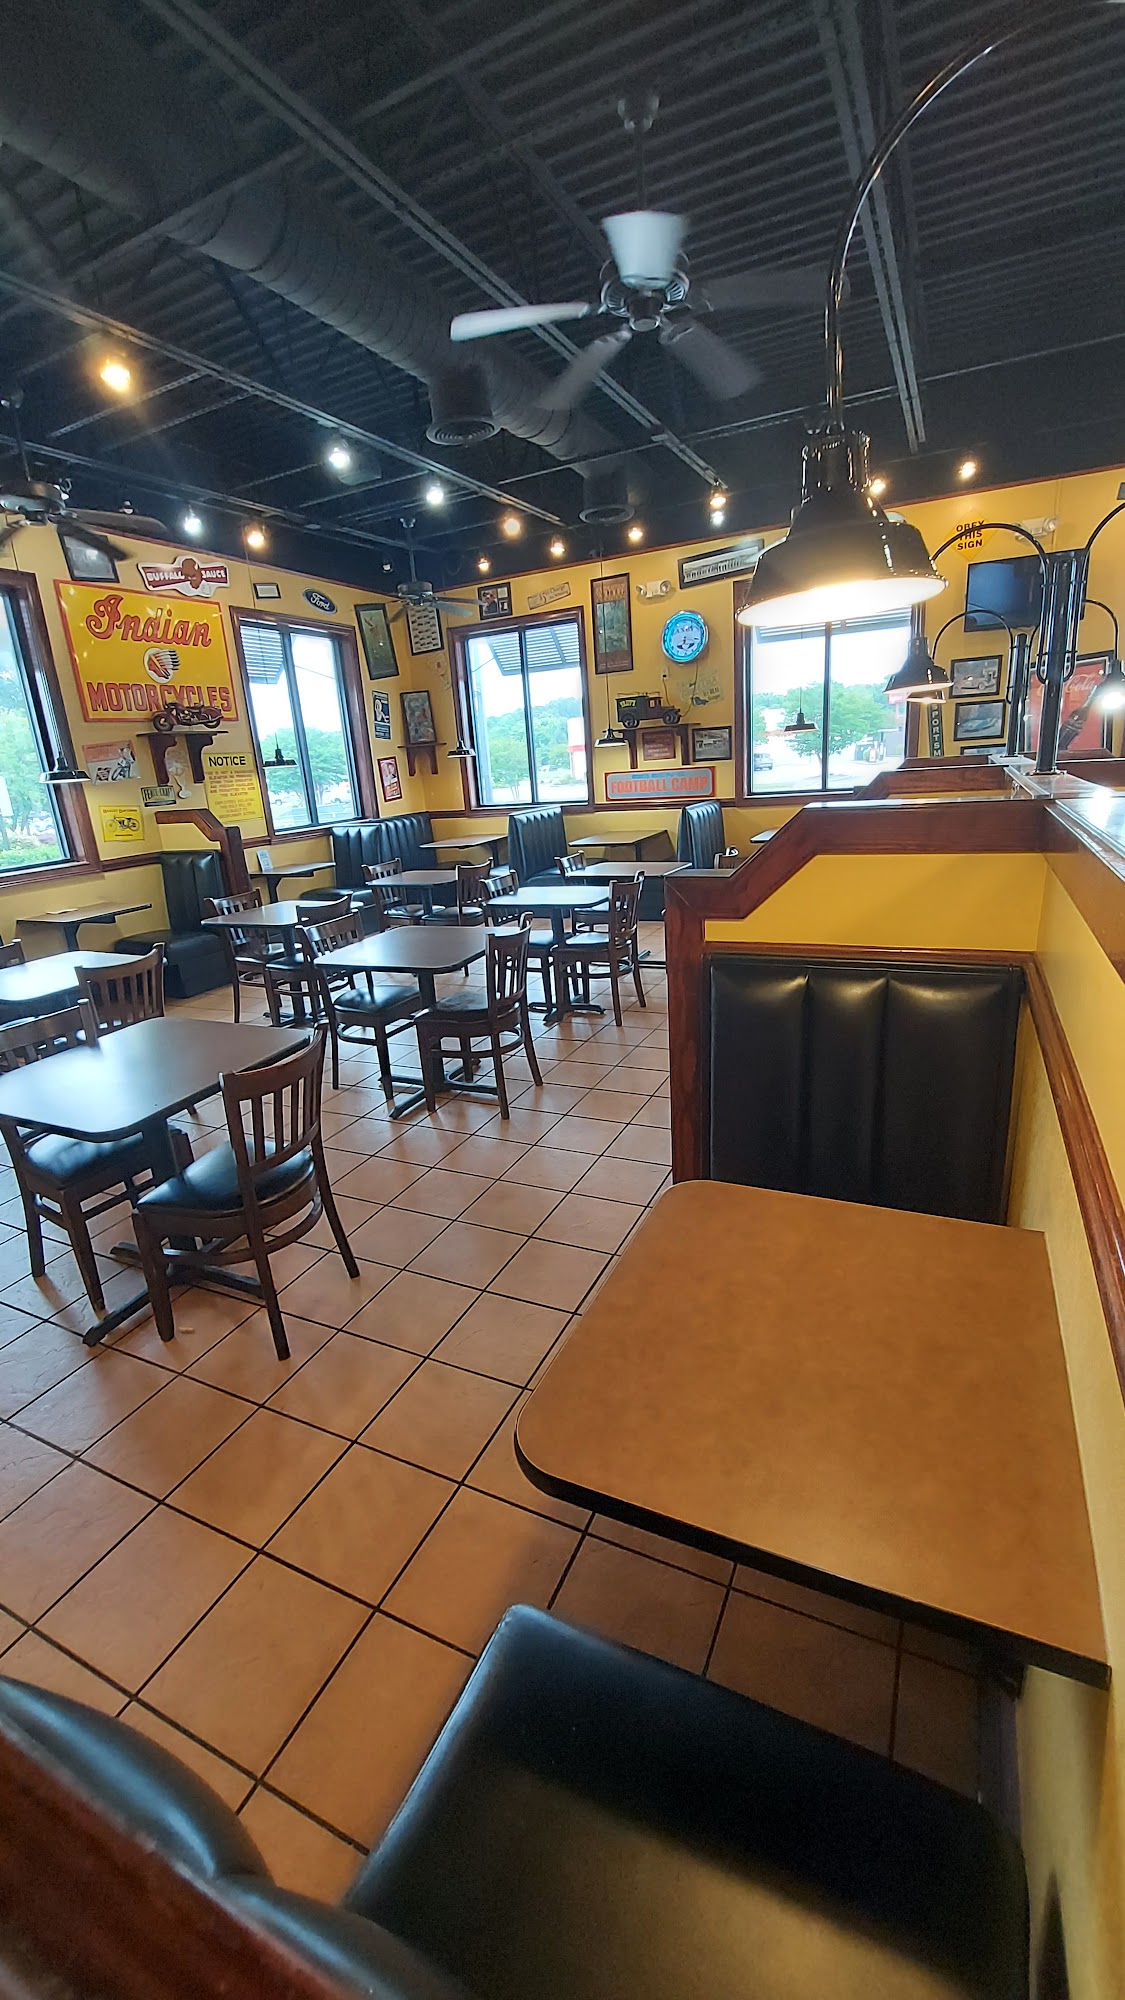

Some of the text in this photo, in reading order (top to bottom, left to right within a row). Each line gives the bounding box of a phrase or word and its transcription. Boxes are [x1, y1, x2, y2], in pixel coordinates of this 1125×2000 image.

[957, 539, 983, 551] SIGN
[201, 569, 226, 579] SAUCE
[310, 592, 330, 611] Ford
[86, 594, 212, 648] Indian
[86, 682, 232, 712] MOTORCYCLES
[208, 756, 246, 767] NOTICE
[611, 776, 708, 794] FOOTBALL CAMP
